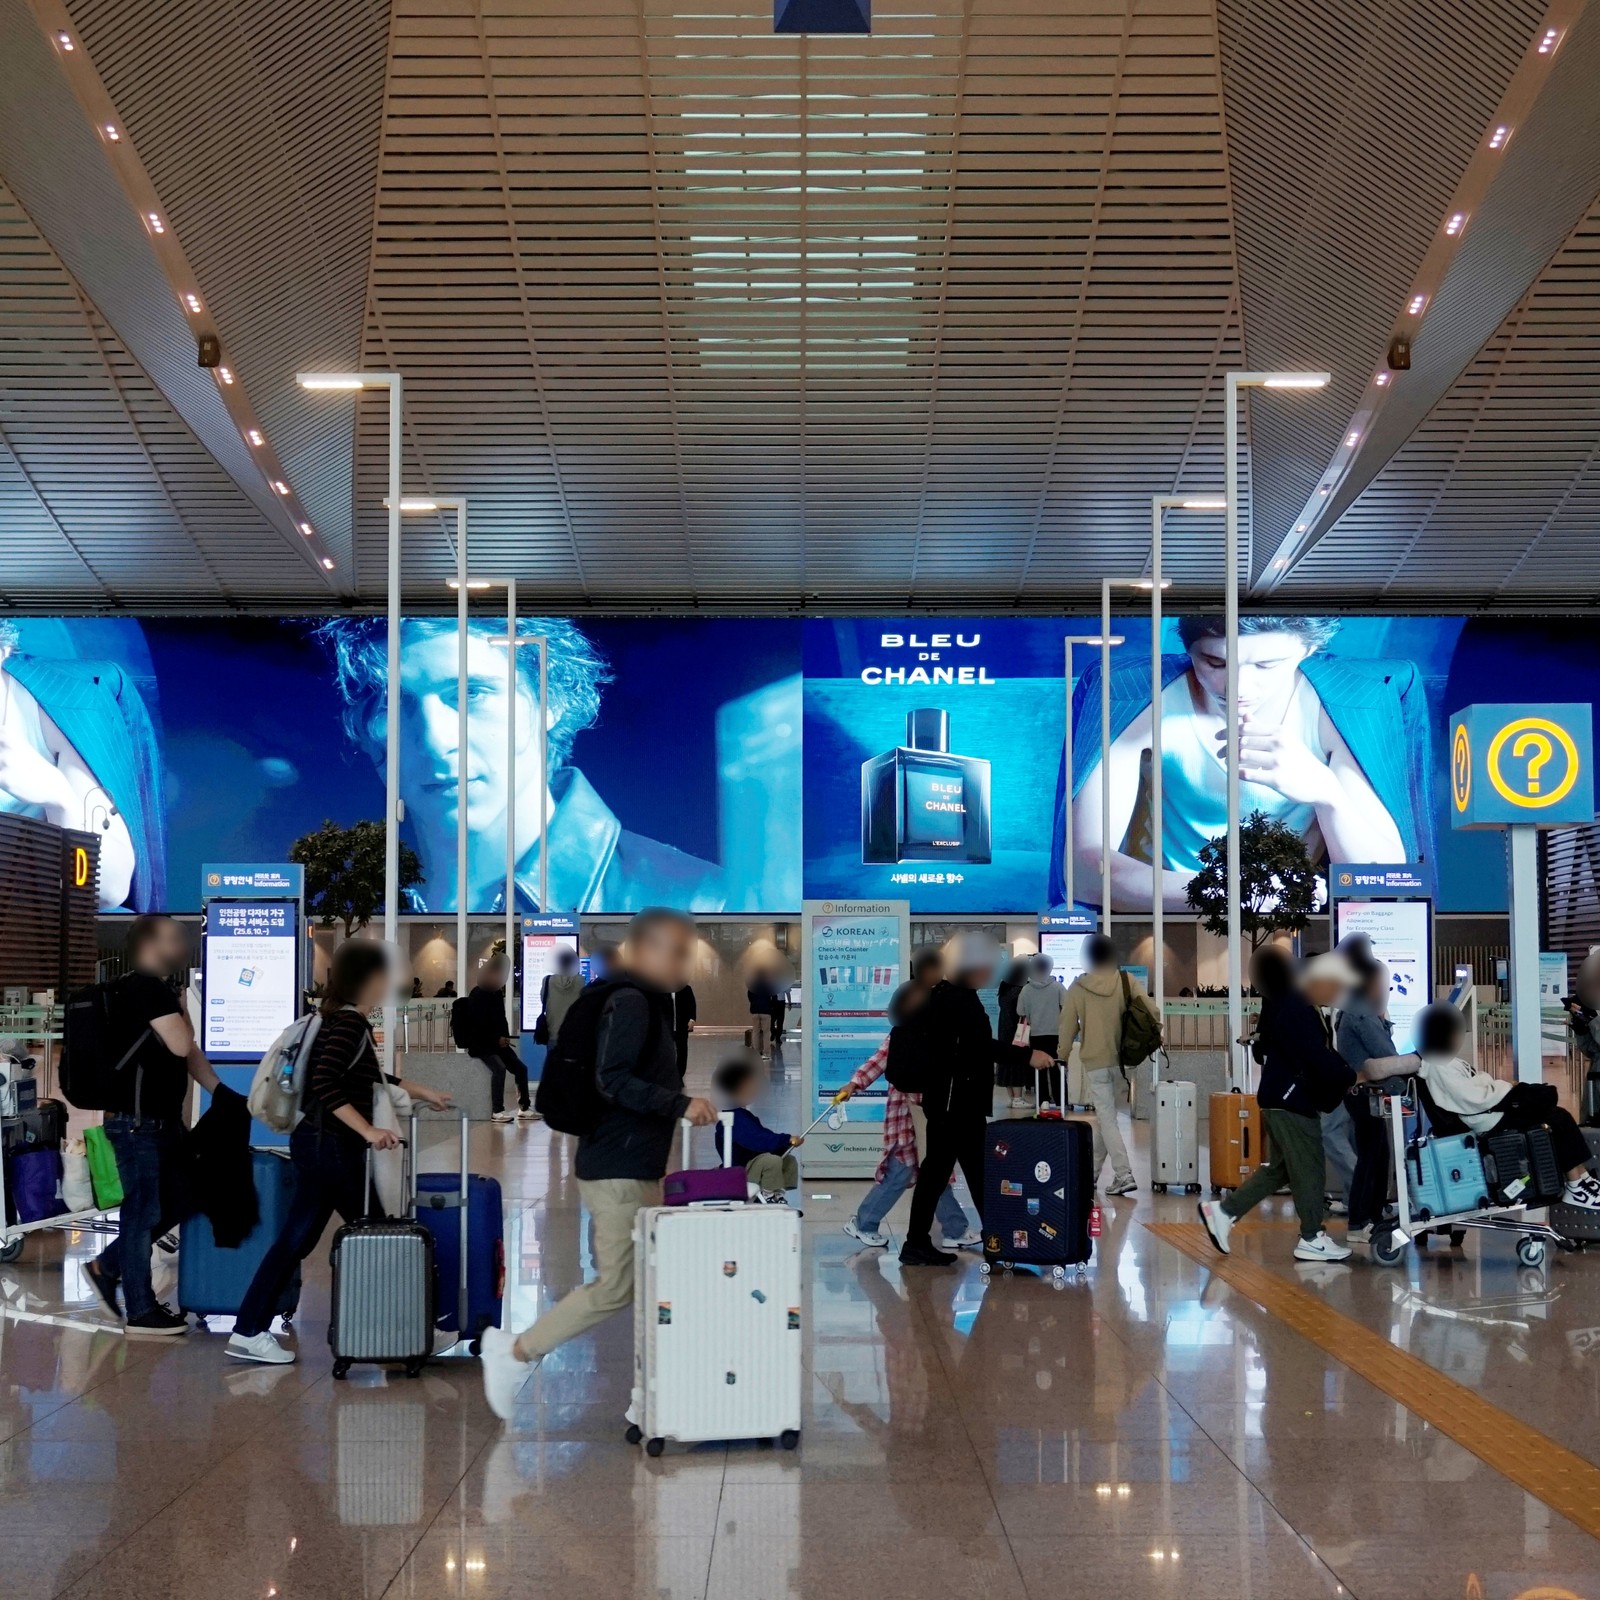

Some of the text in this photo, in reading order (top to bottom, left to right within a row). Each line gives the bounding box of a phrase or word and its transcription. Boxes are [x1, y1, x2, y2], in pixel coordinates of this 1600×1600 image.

[881, 634, 981, 648] BLEU
[918, 652, 940, 661] DE
[861, 666, 996, 685] CHANEL
[931, 783, 962, 793] BLEU
[926, 801, 966, 812] CHANEL
[75, 847, 88, 886] D
[223, 876, 253, 886] 공항안내
[918, 873, 945, 884] 새로운
[946, 873, 964, 884] 향수
[1354, 875, 1385, 885] 공항안내
[218, 908, 285, 918] 인천공항 다자녀 가구
[835, 904, 891, 913] Information
[218, 917, 285, 927] 우선출국 서비스 도입
[836, 928, 876, 936] KOREAN
[843, 1145, 886, 1154] Incheon Airpo
